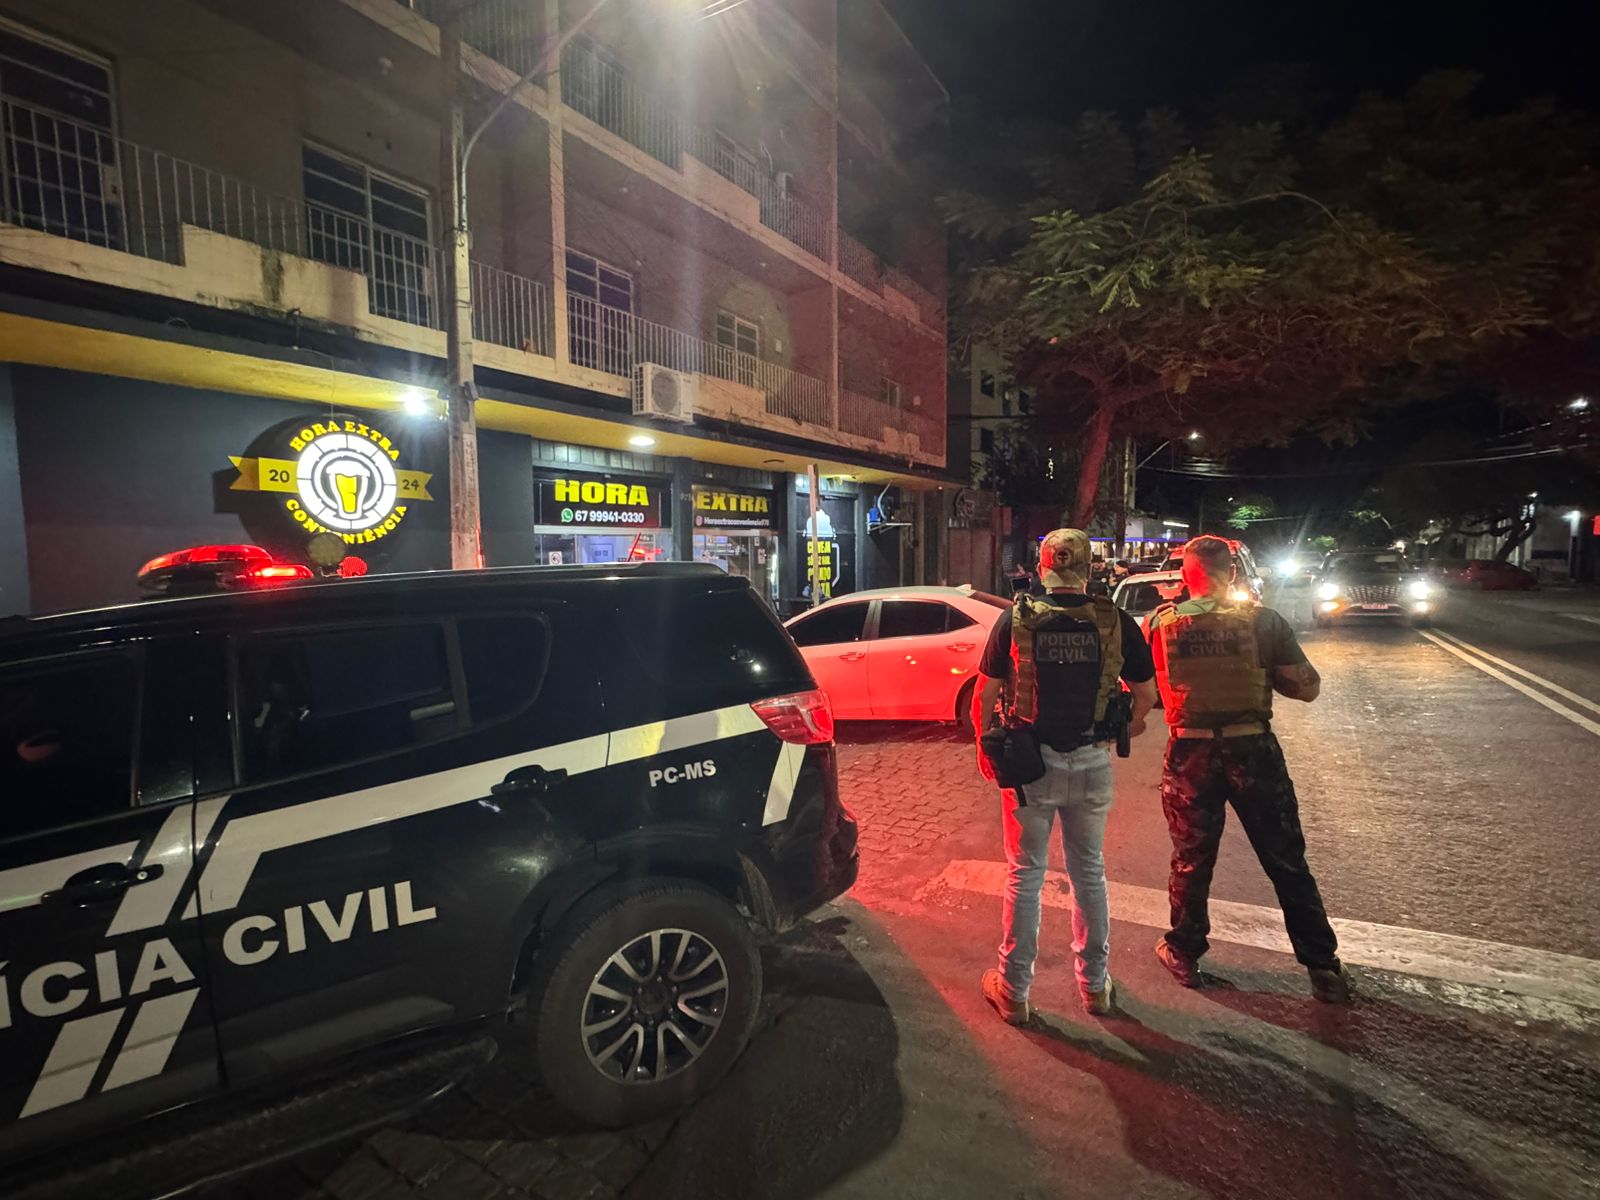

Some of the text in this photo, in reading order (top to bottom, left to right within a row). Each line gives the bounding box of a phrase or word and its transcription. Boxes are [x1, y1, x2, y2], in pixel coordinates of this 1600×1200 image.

[290, 420, 400, 461] HORA EXTRA
[268, 468, 290, 483] 20
[402, 479, 420, 491] 24
[555, 479, 650, 506] HORA
[696, 490, 769, 513] EXTRA
[286, 498, 408, 545] CONNIÊNCIA
[575, 510, 645, 523] 67 99941-0330
[1048, 647, 1089, 661] CIVIL
[1189, 643, 1231, 656] CIVIL
[648, 759, 717, 787] PC-MS
[222, 880, 438, 966] CIVIL
